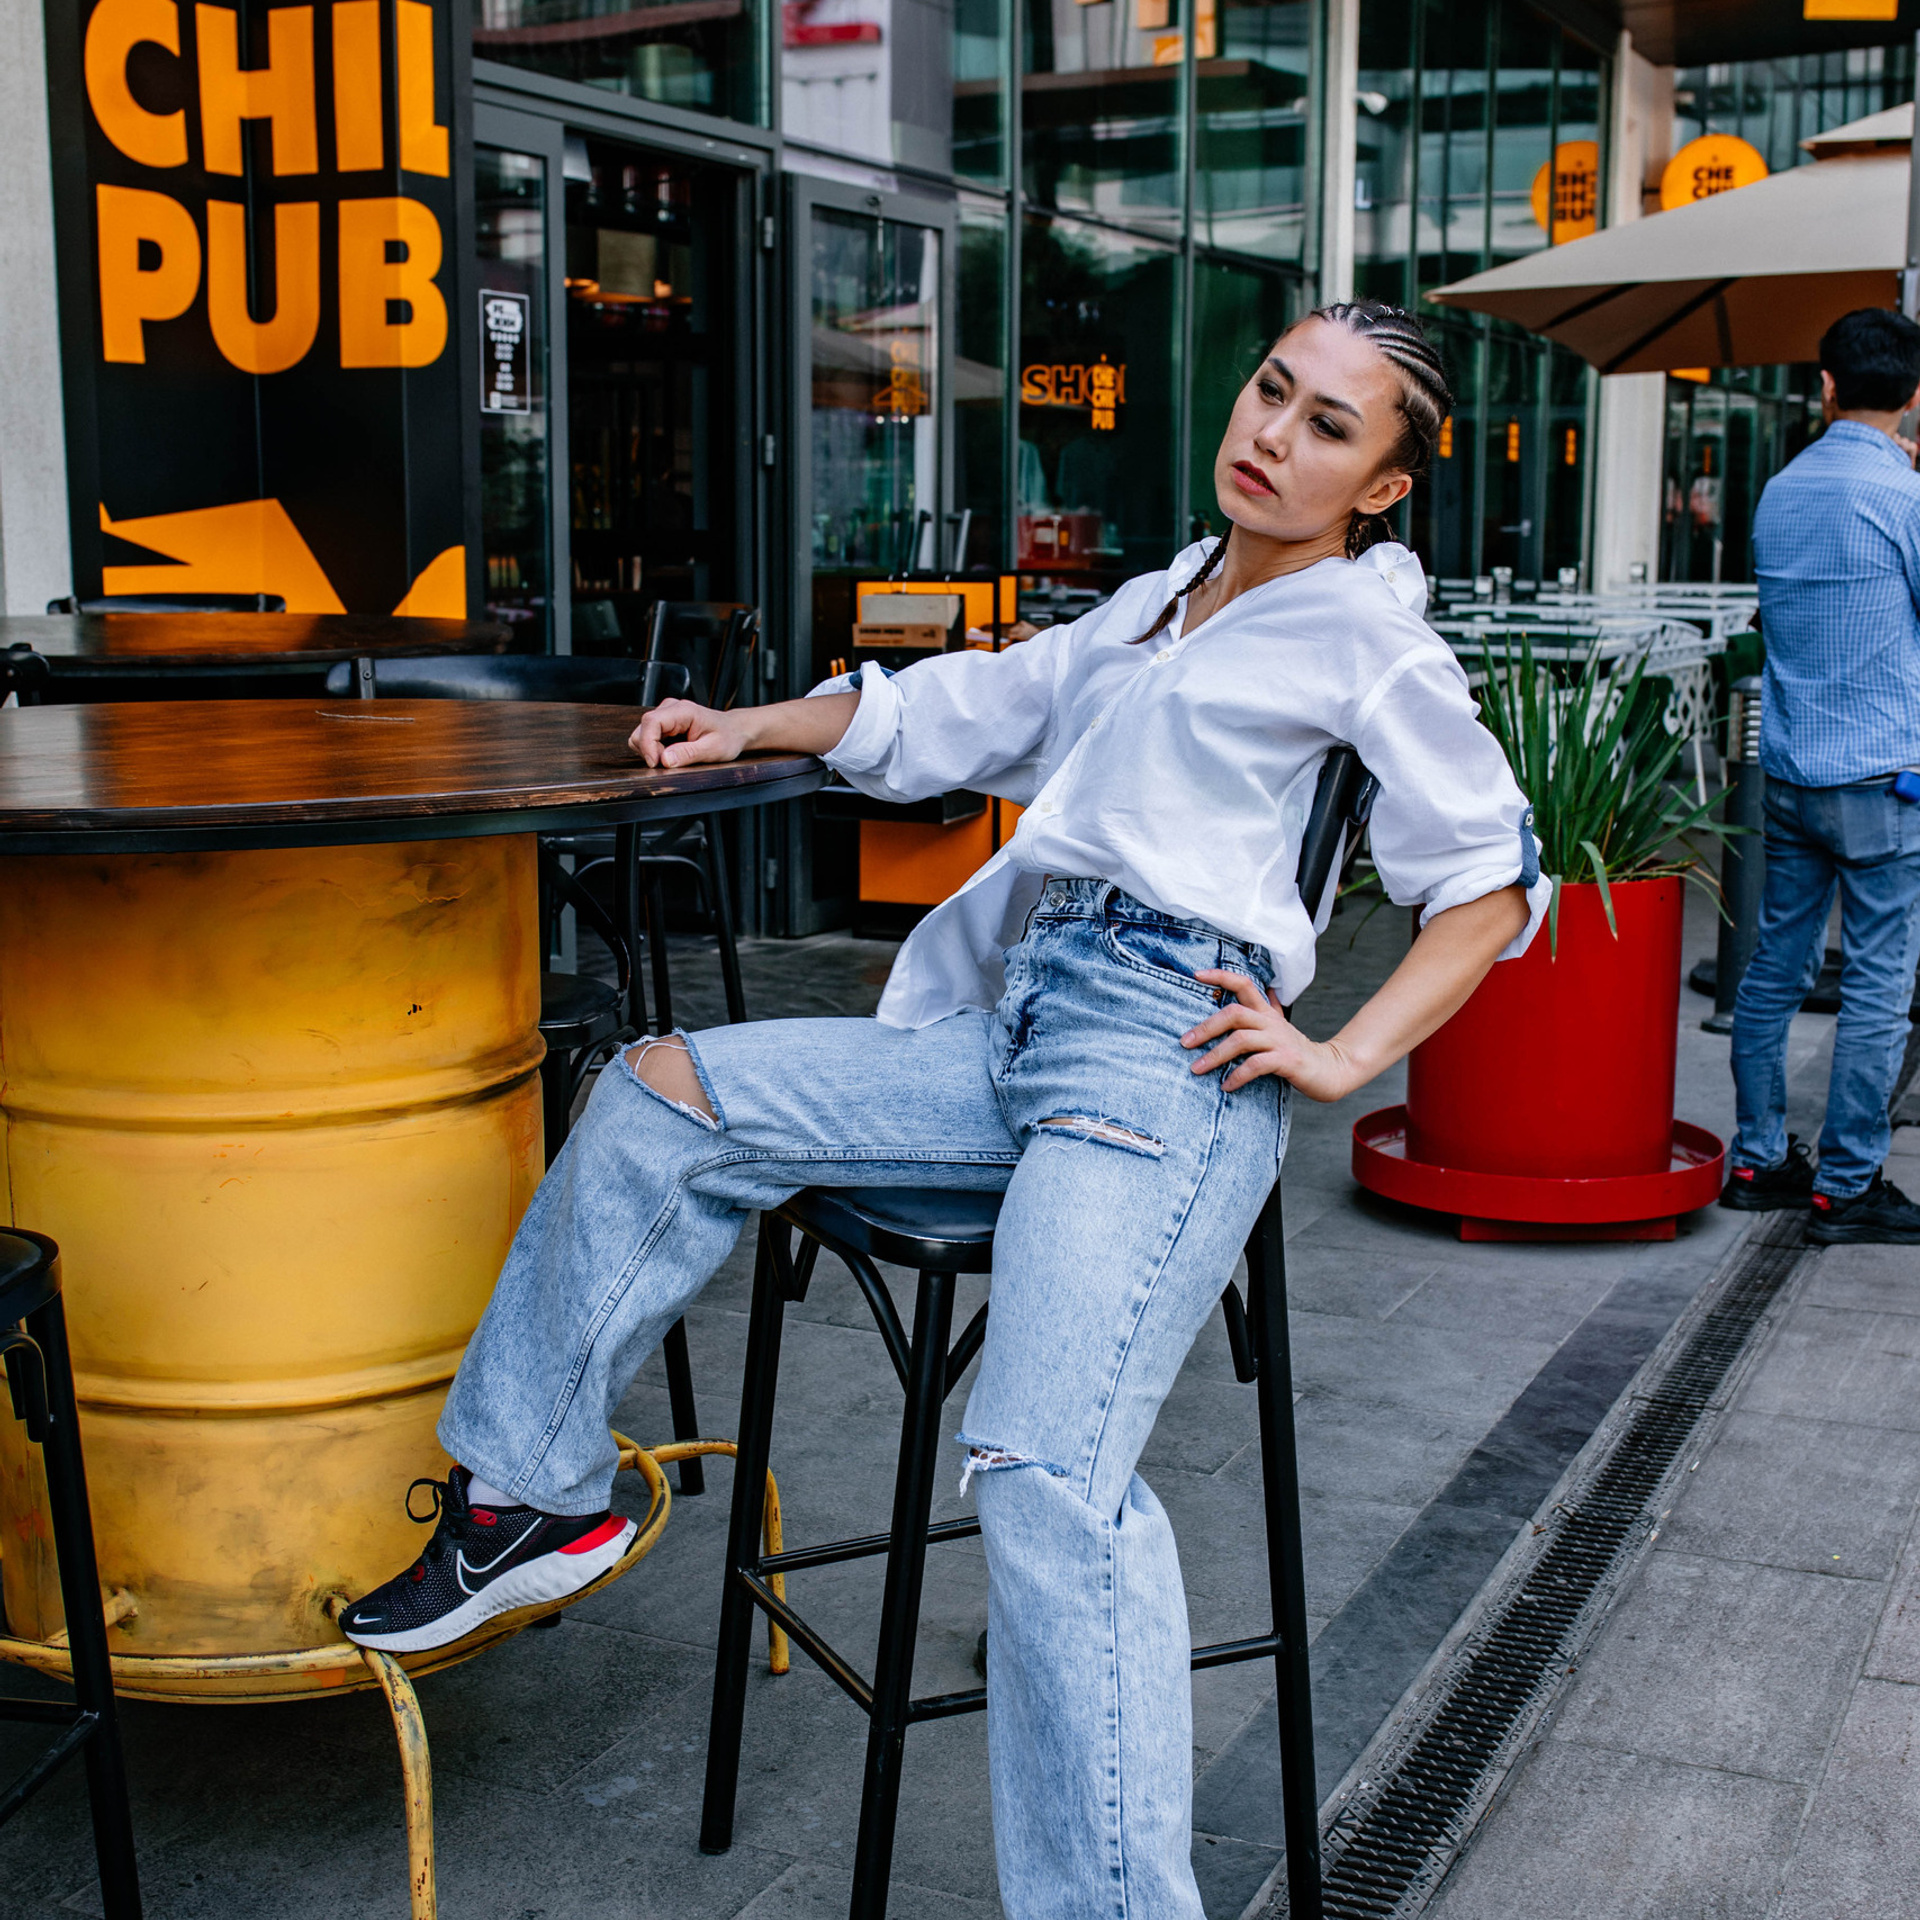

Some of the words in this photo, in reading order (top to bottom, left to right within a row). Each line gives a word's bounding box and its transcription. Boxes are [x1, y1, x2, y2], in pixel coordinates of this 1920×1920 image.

[84, 0, 449, 178] CHIL
[1693, 165, 1734, 181] CHE
[96, 183, 449, 374] PUB
